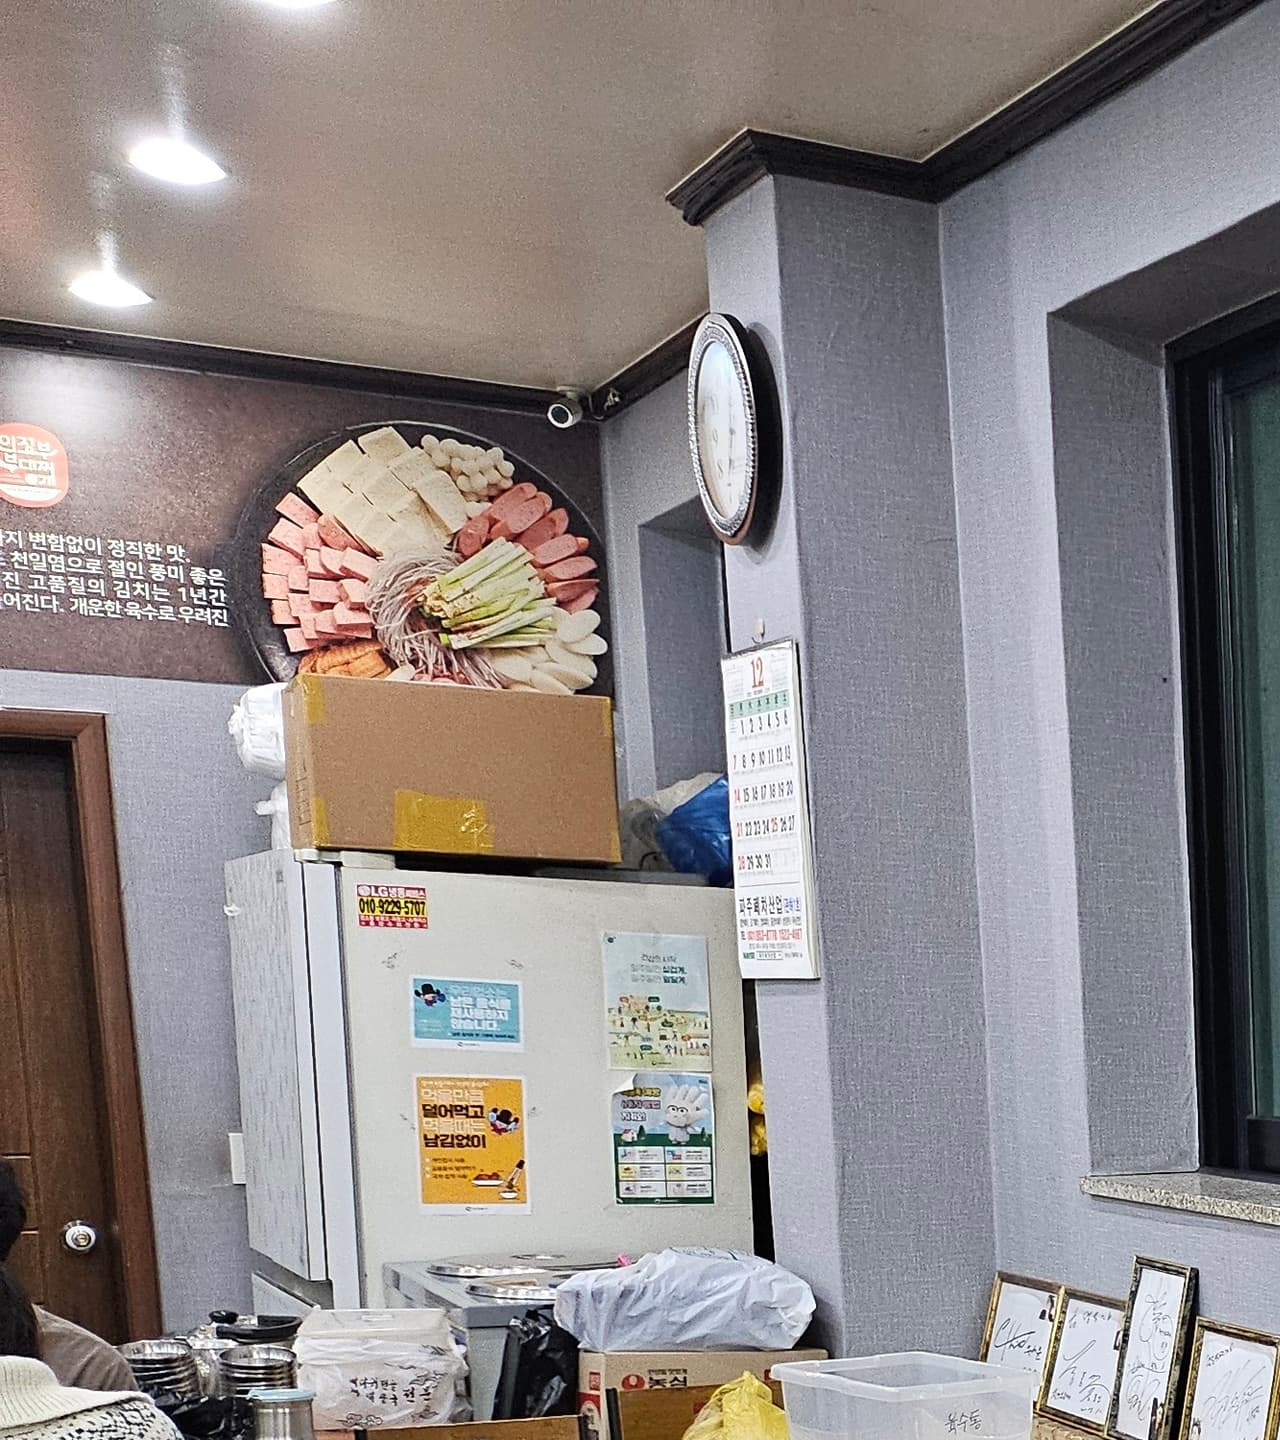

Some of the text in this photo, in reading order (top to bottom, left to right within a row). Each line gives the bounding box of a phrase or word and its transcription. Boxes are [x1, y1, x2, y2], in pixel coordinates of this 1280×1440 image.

[28, 532, 102, 556] 변함없이
[107, 539, 162, 562] 정직한
[166, 544, 192, 564] 맛.
[10, 550, 227, 588] 천일염으로 절인 풍미 좋은
[0, 571, 230, 608] 진 고품질의 김치는 1년간
[70, 598, 124, 619] 개운한
[750, 656, 765, 689] 12
[358, 898, 426, 916] 010-9229-5707
[421, 1103, 486, 1119] 덜어먹고
[423, 1133, 487, 1149] 남김없이
[648, 1376, 688, 1388] 농심
